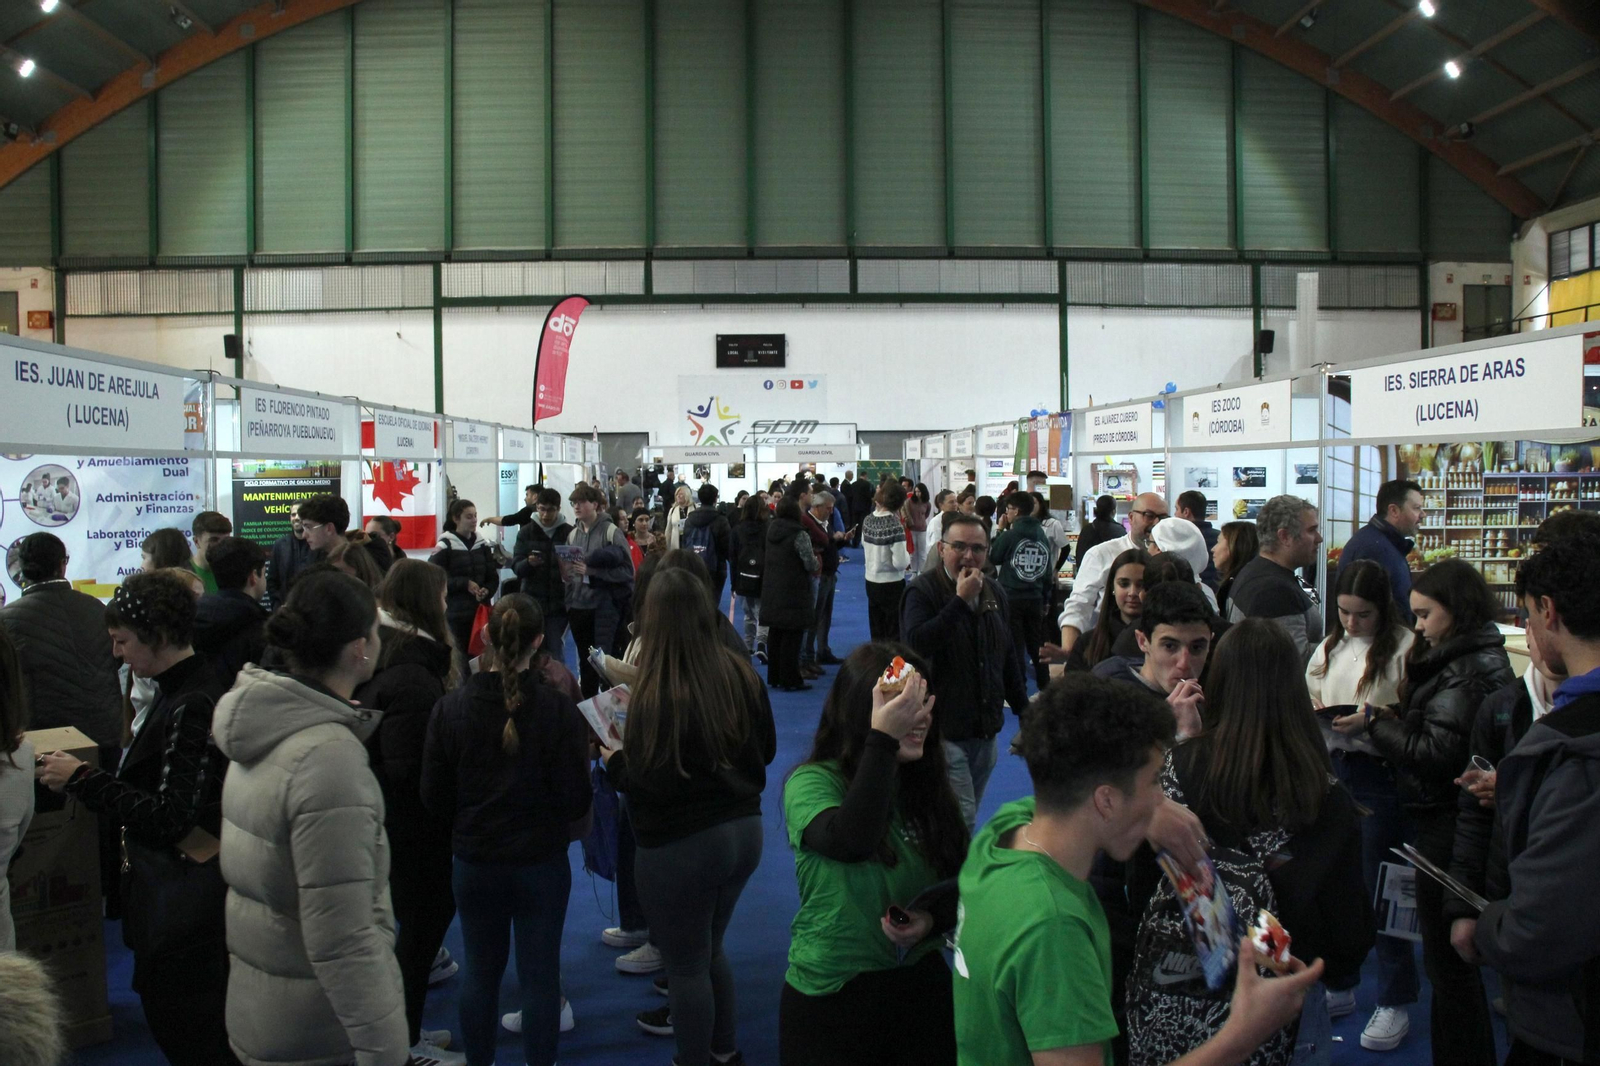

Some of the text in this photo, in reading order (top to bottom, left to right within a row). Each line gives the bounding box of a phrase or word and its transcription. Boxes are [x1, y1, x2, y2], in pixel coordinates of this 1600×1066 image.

[15, 360, 160, 400] IES. JUAN DE AREJULA
[1384, 357, 1526, 392] IES. SIERRA DE ARAS
[255, 397, 330, 421] IES FLORENCIO PINTADO
[1211, 396, 1241, 413] IES ZOCO
[1415, 398, 1479, 427] (LUCENA)
[1120, 411, 1138, 423] CUBERO
[247, 419, 336, 442] (PEÑARROYA PUEBLONUEVO)
[746, 419, 820, 435] SDM
[1208, 418, 1245, 438] (CÓRDOBA)
[740, 435, 810, 445] Lucena
[1109, 432, 1115, 443] DE
[162, 467, 189, 477] Dual
[95, 491, 194, 503] Administración
[135, 503, 194, 516] y Finanzas
[264, 503, 291, 514] VEHÍC
